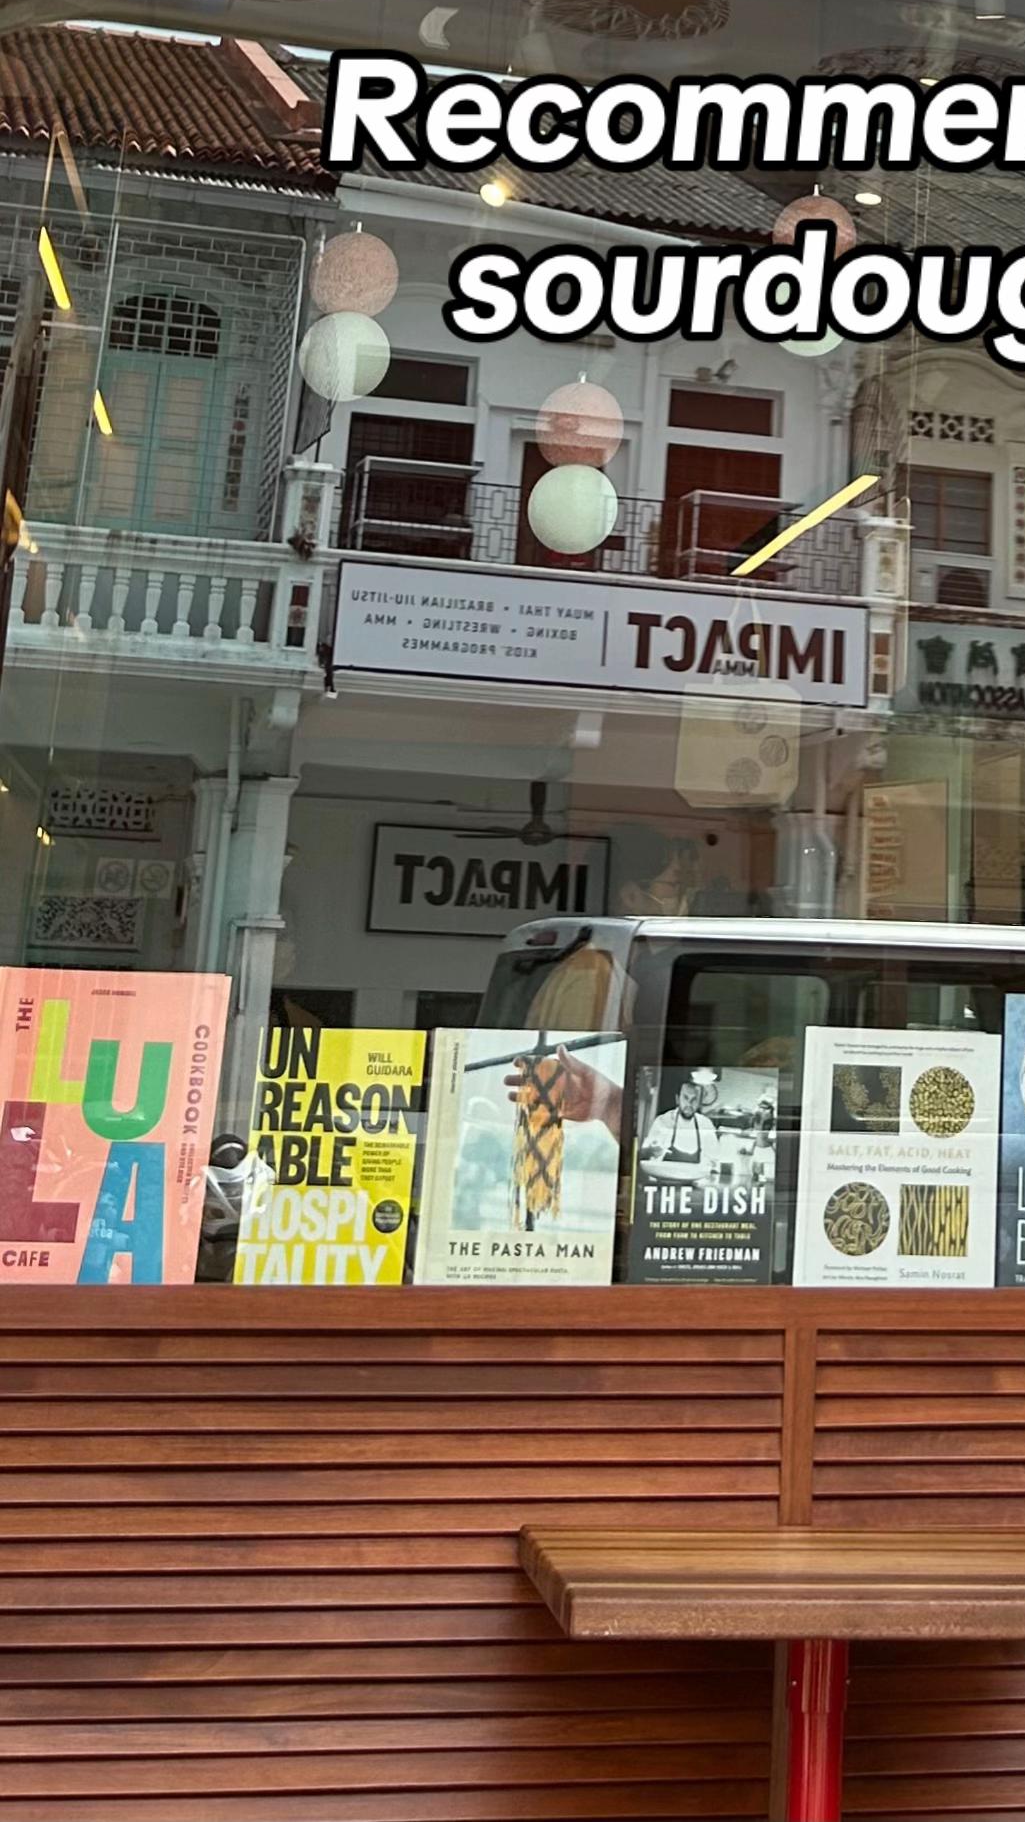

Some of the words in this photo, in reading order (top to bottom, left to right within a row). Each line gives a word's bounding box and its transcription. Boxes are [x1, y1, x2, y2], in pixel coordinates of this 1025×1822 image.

[15, 996, 35, 1032] THE
[260, 1026, 322, 1080] UN
[367, 1052, 393, 1063] WILL
[183, 1023, 211, 1135] COOKBOOK
[366, 1064, 413, 1076] GUIDARA
[252, 1081, 425, 1135] REASON
[936, 1148, 972, 1161] HEAT
[643, 1185, 694, 1215] THE
[703, 1186, 766, 1215] DISH
[1, 1250, 50, 1268] CAFE
[449, 1241, 481, 1257] THE
[491, 1242, 546, 1258] PASTA
[556, 1244, 595, 1259] MAN
[643, 1247, 695, 1261] ANDREW
[698, 1247, 761, 1261] FRIEDMAN
[237, 1243, 389, 1285] TALITY
